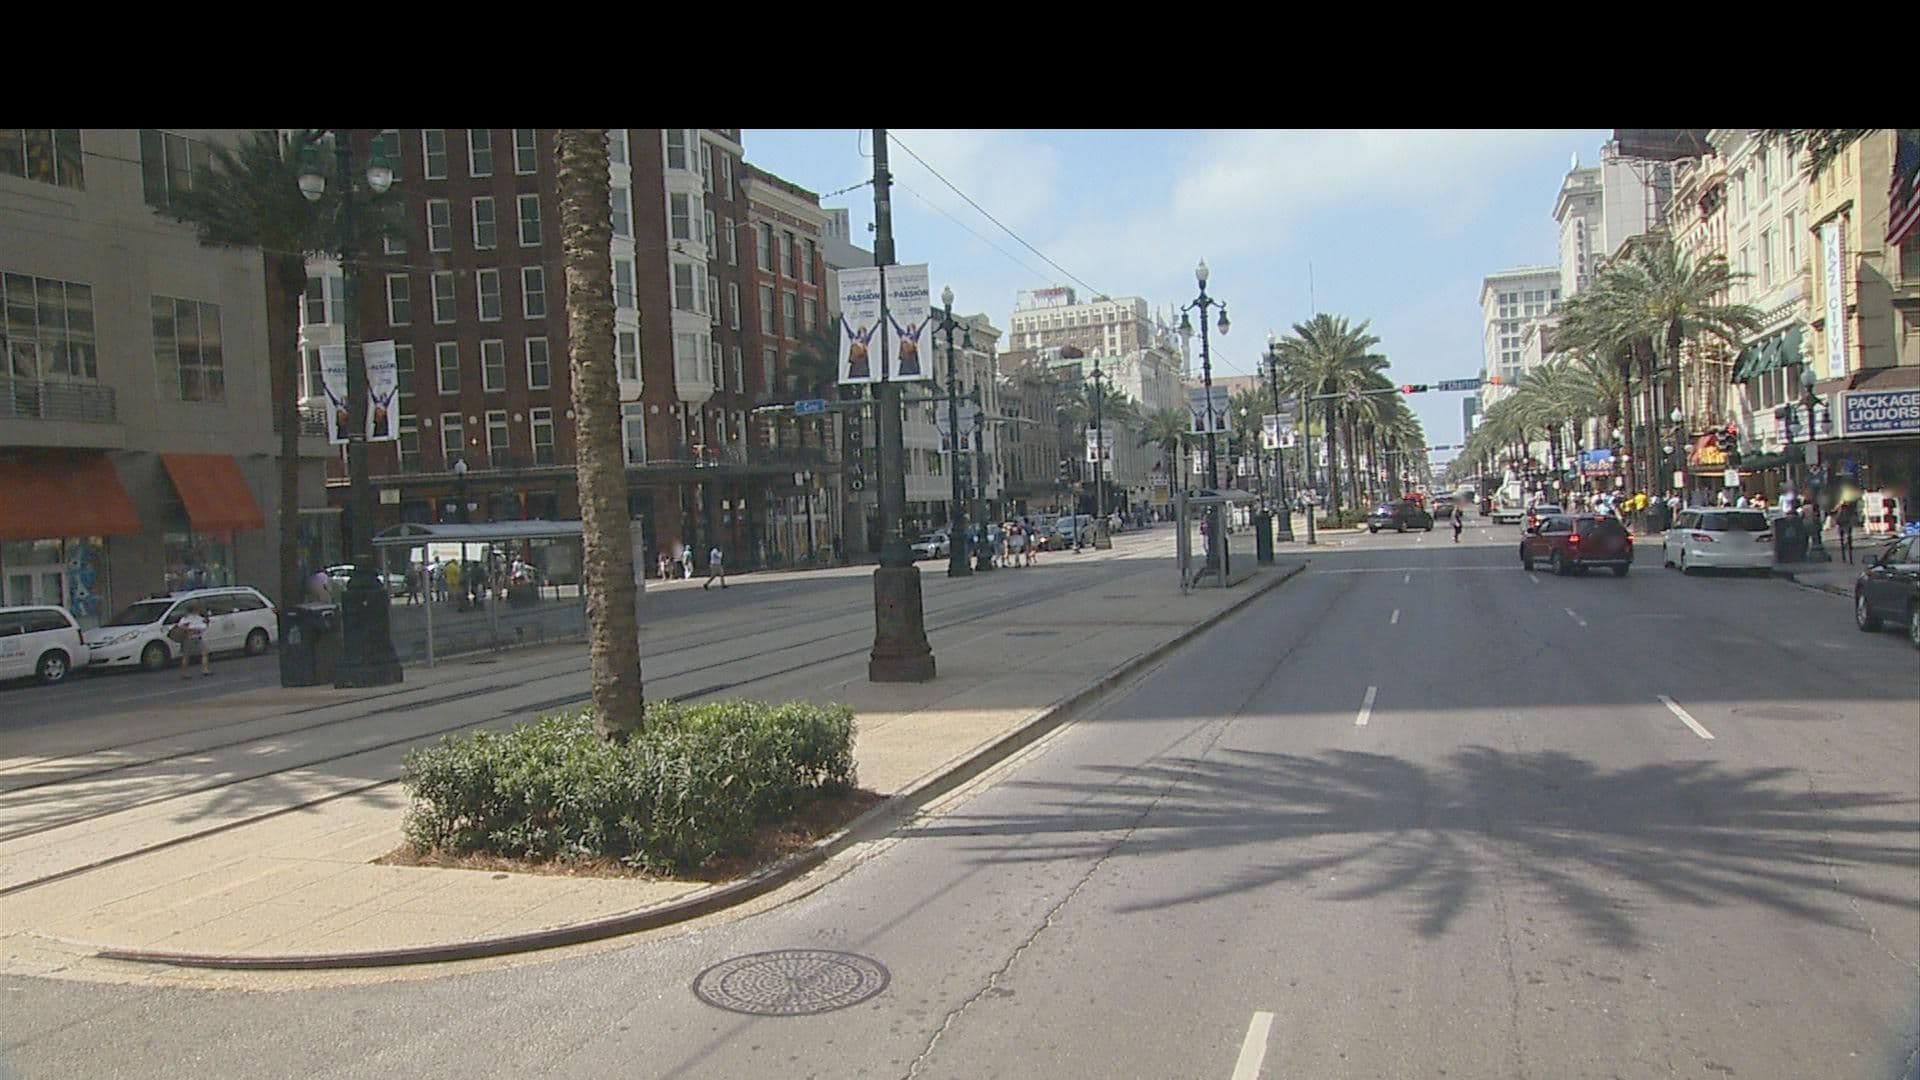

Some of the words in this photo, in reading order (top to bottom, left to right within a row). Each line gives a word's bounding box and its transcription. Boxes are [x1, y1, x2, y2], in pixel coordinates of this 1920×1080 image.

[1827, 233, 1838, 287] JAZZ
[847, 293, 880, 302] PASSION
[894, 289, 929, 298] PASSION
[1828, 299, 1839, 350] CITY
[1847, 394, 1920, 409] PACKAGE
[1850, 406, 1920, 421] LIQUORS
